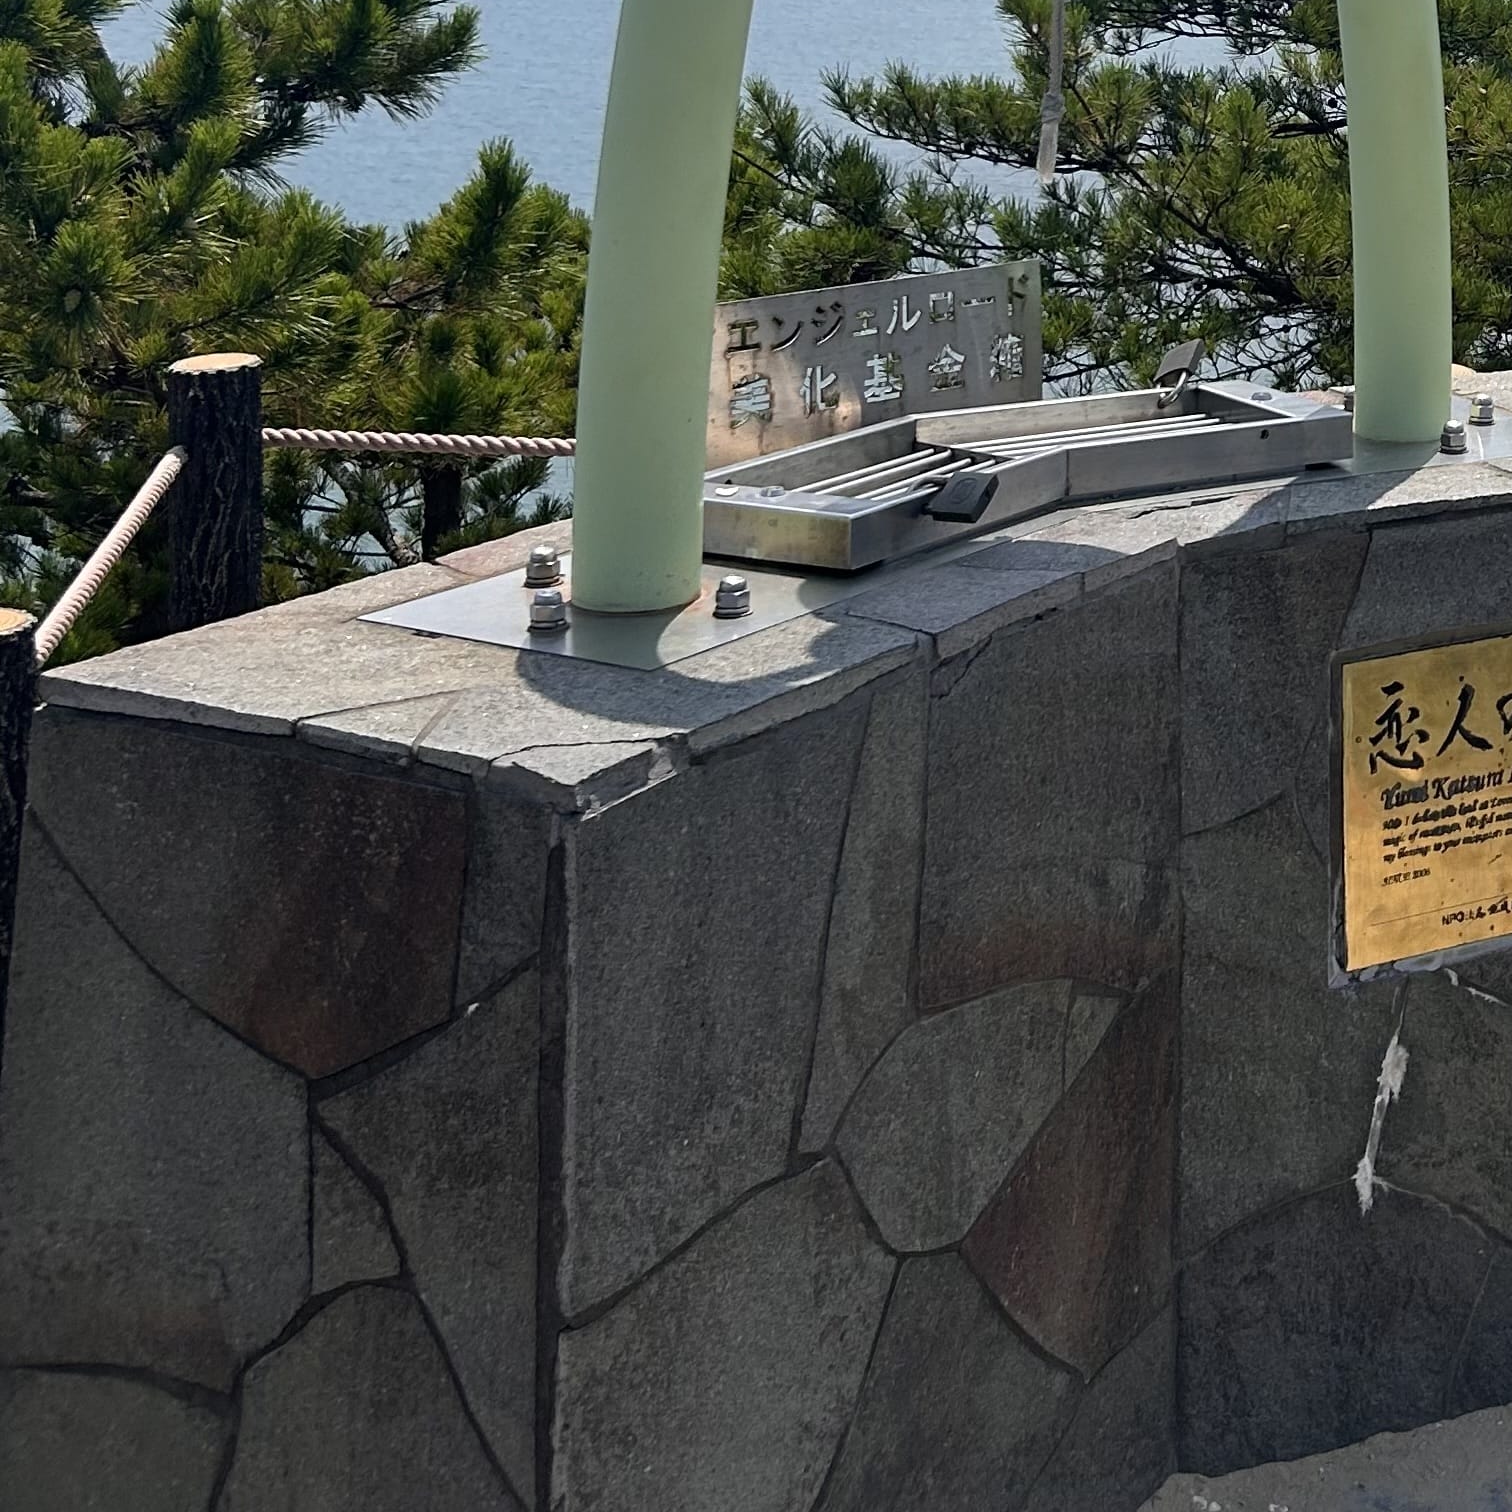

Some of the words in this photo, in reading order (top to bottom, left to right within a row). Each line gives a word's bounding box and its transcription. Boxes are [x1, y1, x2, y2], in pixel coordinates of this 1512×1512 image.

[726, 273, 1030, 359] エンジェルロード
[1431, 768, 1505, 801] Katsura
